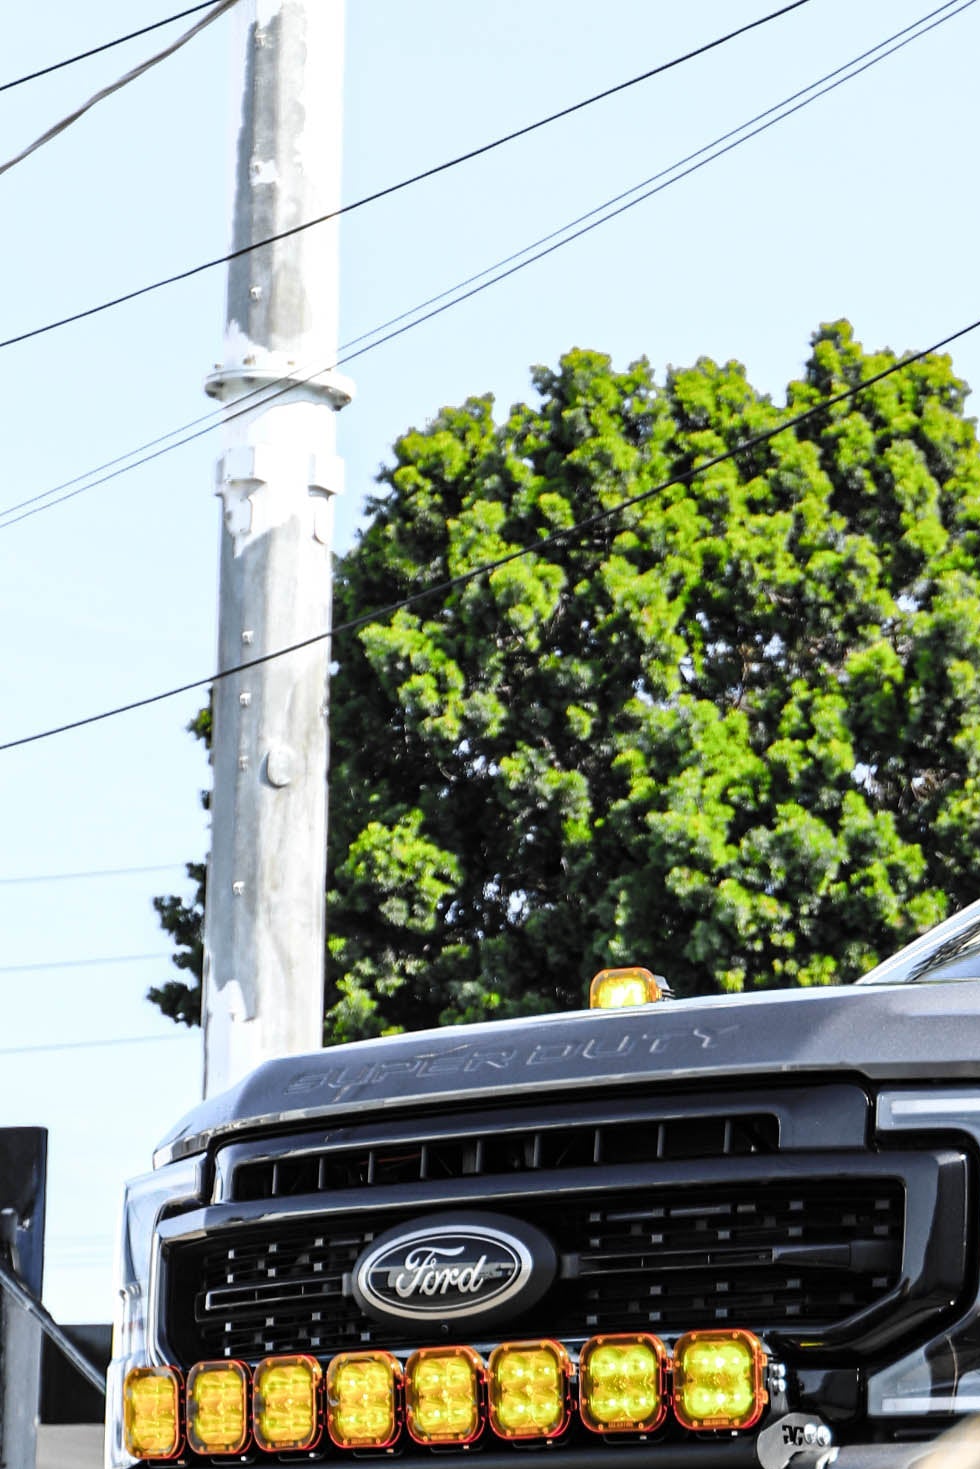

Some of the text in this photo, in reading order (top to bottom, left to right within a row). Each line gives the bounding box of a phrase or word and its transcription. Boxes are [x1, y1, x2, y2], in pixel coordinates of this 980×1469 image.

[283, 1024, 740, 1096] SUPER DUTY
[396, 1246, 487, 1298] Ford
